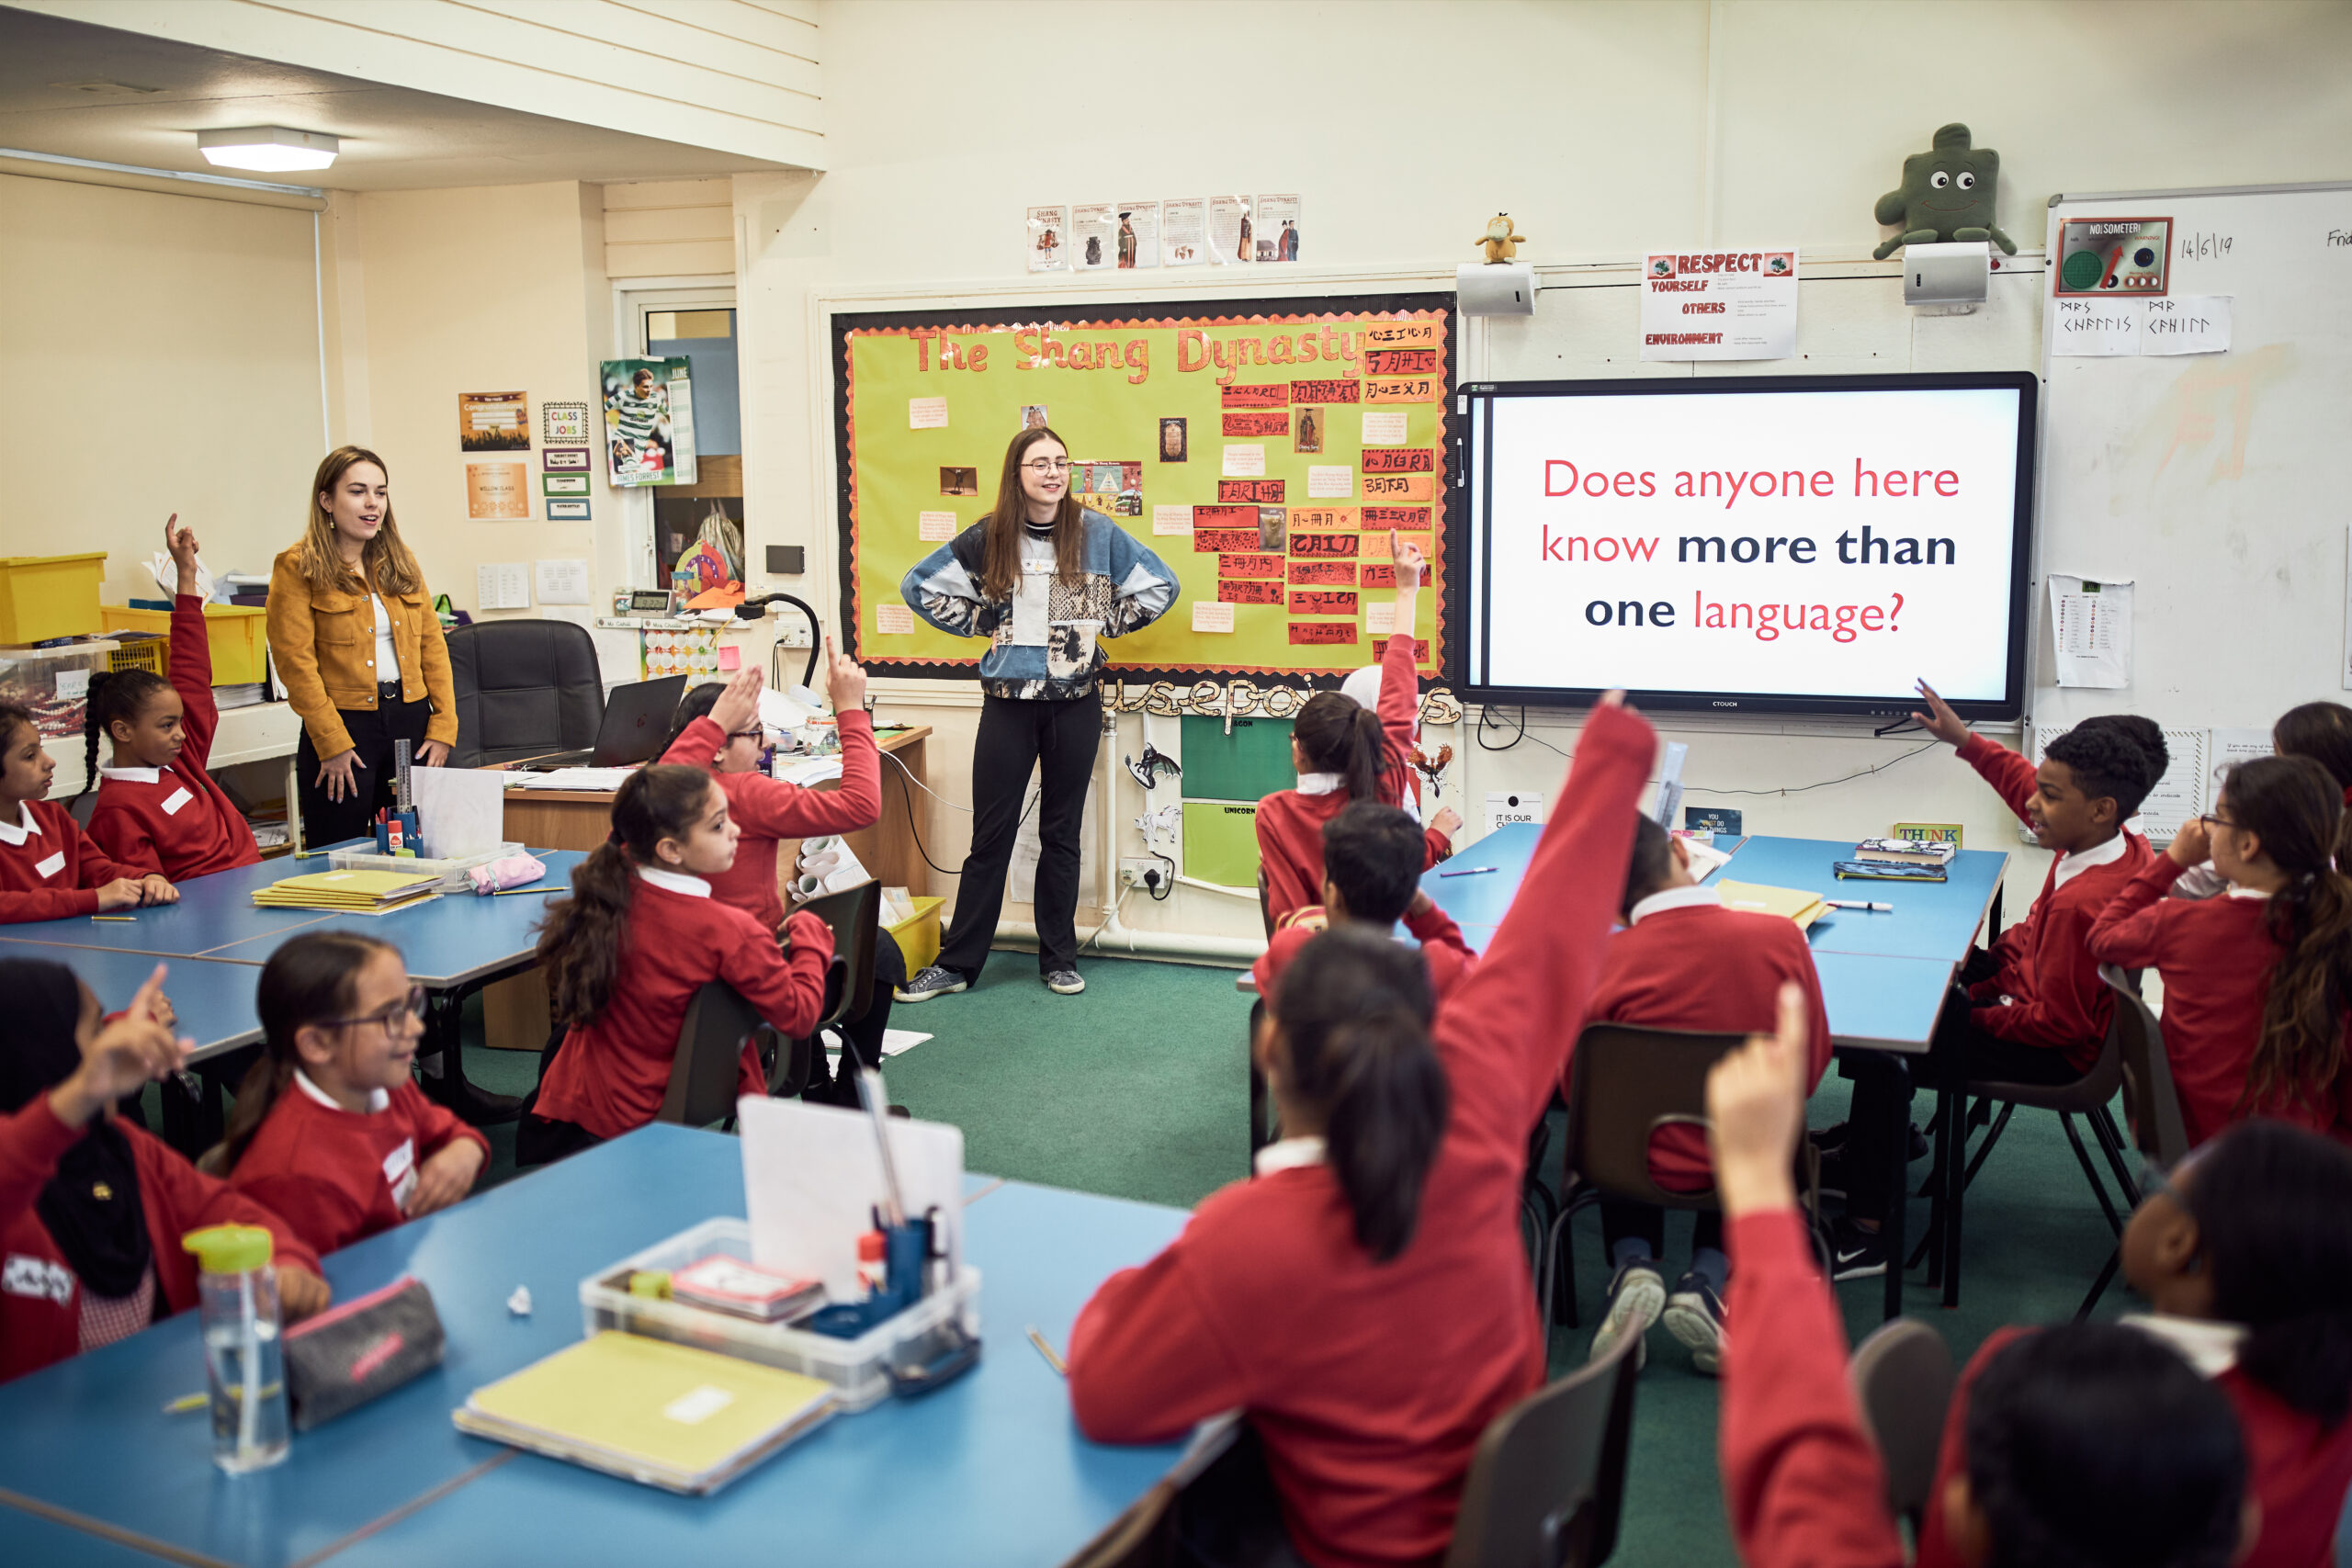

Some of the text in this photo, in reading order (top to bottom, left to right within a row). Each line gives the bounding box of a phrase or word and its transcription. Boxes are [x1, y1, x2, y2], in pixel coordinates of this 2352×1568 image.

[1036, 209, 1057, 218] SHANG
[1678, 253, 1763, 275] RESPECT
[1651, 279, 1709, 292] YOURSELF
[1681, 302, 1726, 314] OTHERS
[1645, 333, 1724, 345] ENVIRONMENT
[909, 325, 1366, 386] The Shang Dynasty
[551, 412, 578, 421] CLASS
[555, 425, 577, 434] JOBS
[1544, 457, 1960, 510] Does anyone here
[1543, 524, 1956, 565] know more than
[1585, 590, 1905, 644] one language?
[1513, 814, 1532, 822] OUR
[1899, 829, 1958, 842] THINK
